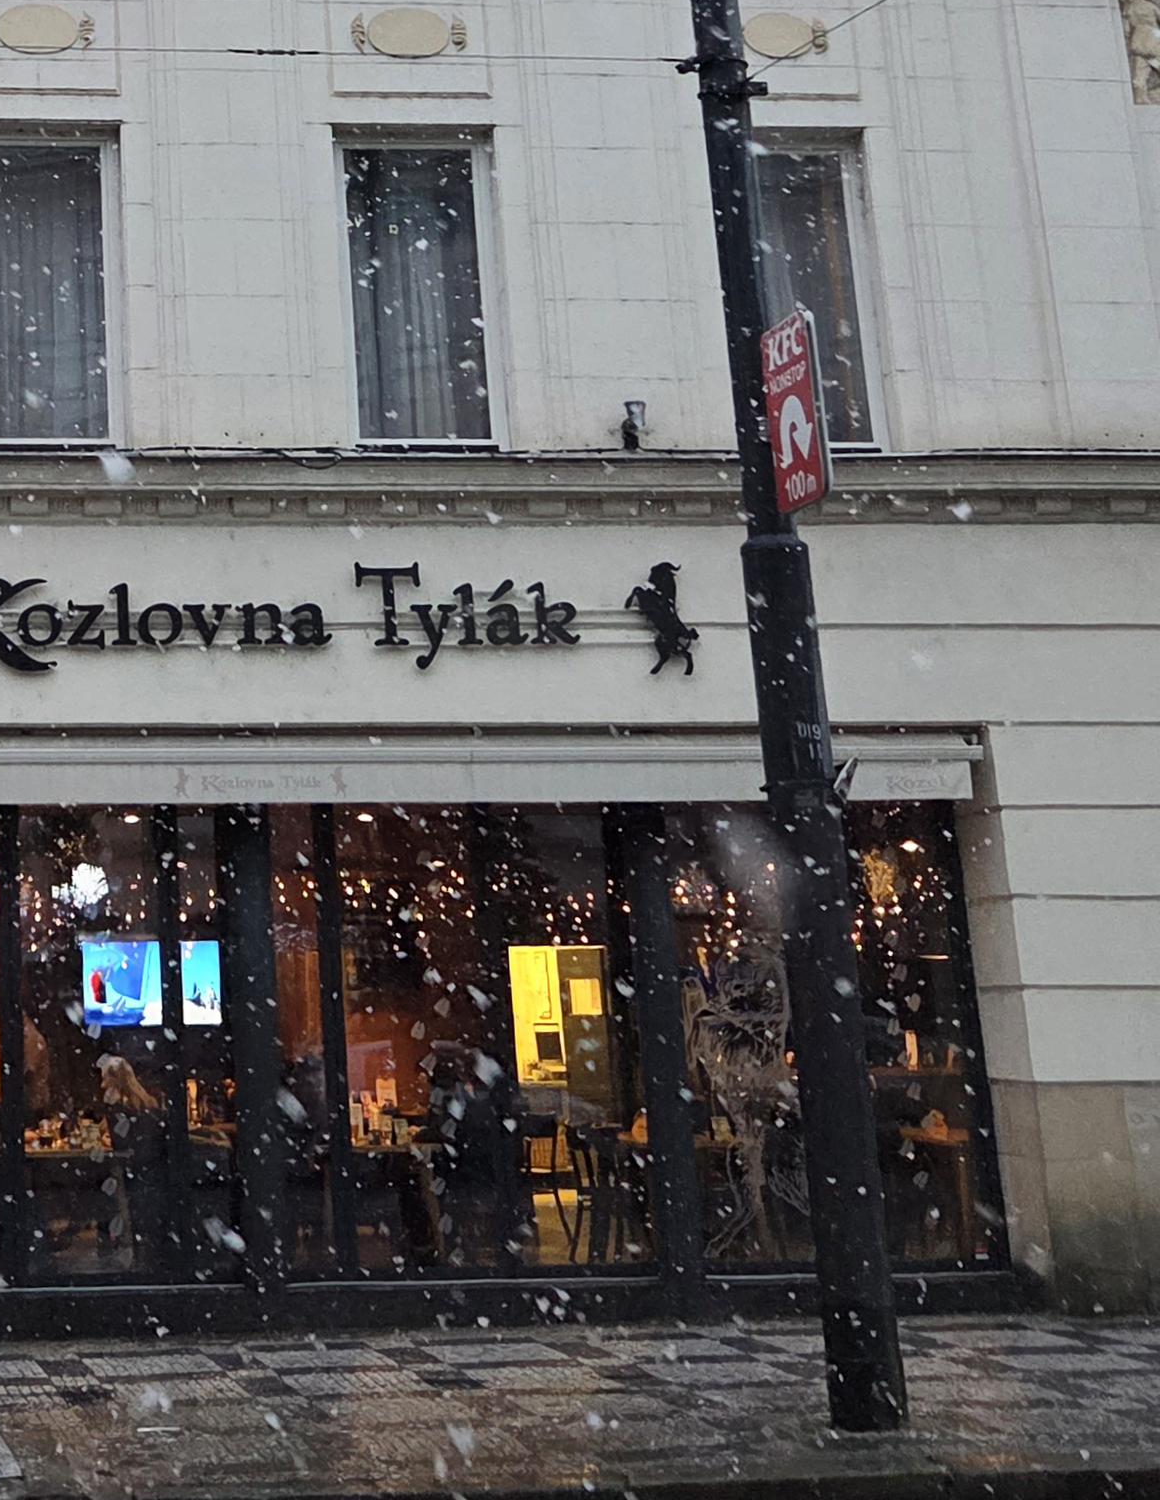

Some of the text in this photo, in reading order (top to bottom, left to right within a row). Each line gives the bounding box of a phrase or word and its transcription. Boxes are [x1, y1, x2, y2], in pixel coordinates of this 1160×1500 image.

[768, 318, 803, 372] KFC
[768, 360, 806, 396] NONSTOP
[785, 470, 817, 501] 100 m
[354, 561, 581, 671] Tylák
[200, 774, 322, 793] Kozlovna Tylák
